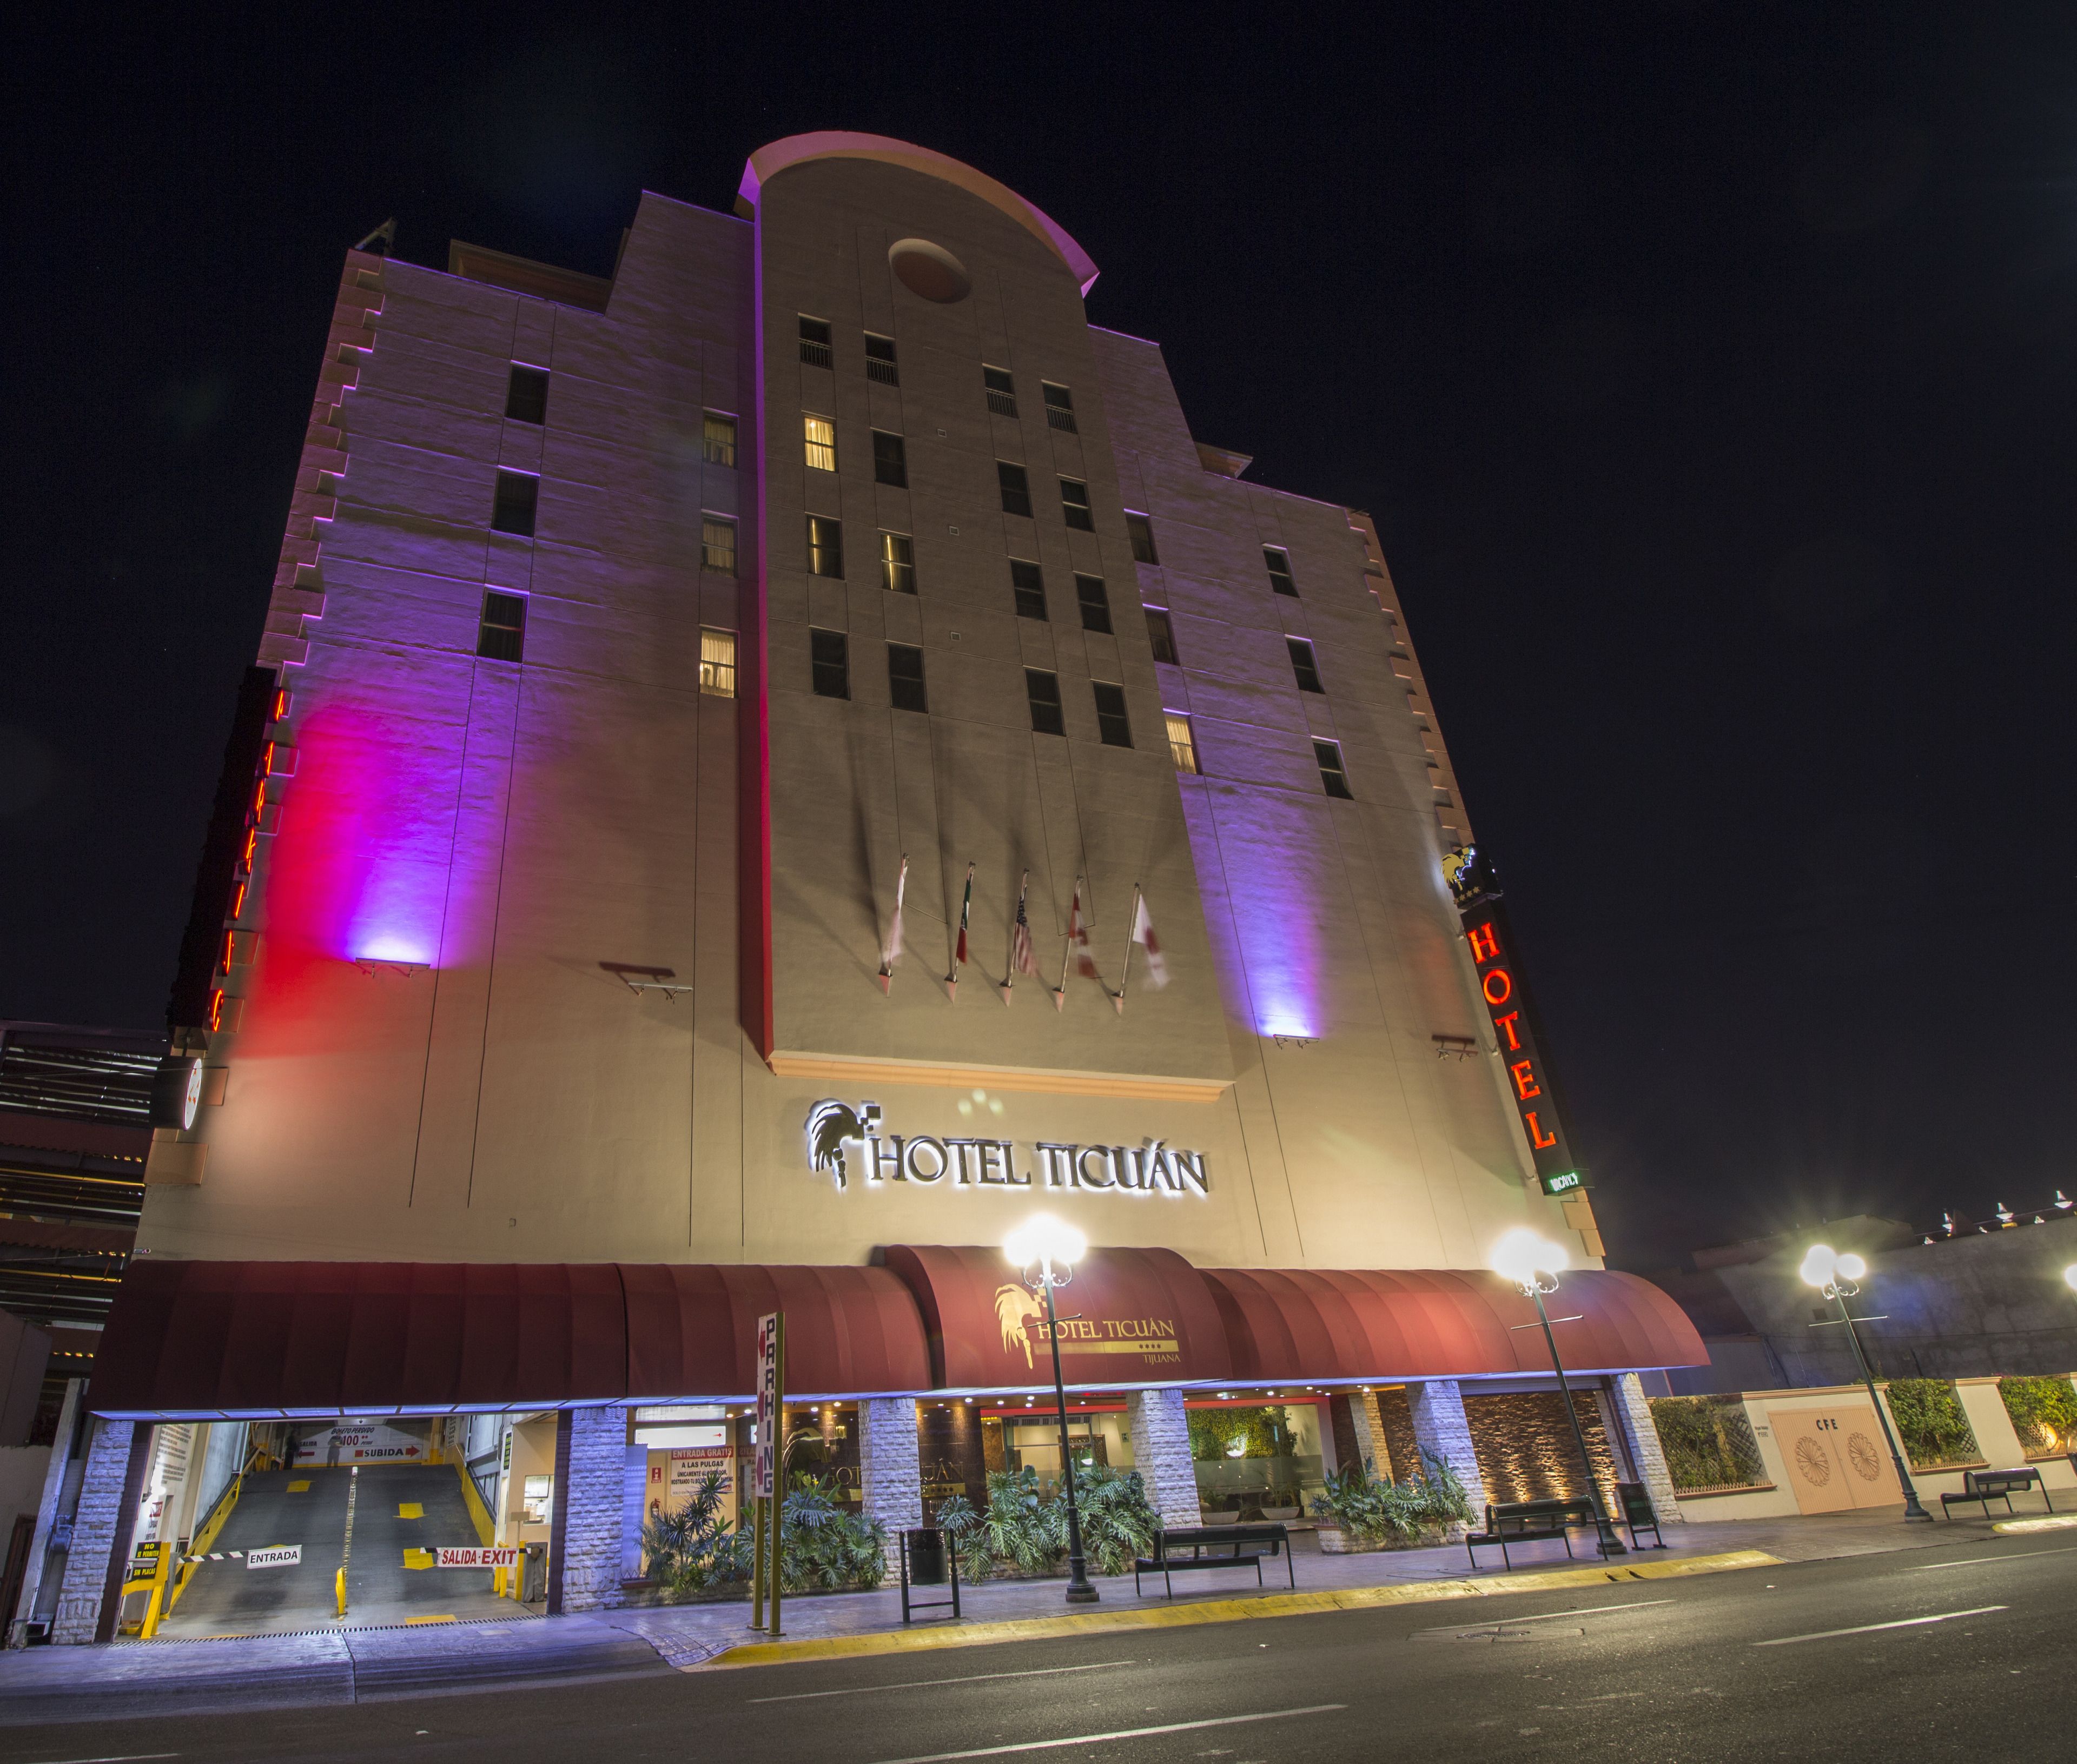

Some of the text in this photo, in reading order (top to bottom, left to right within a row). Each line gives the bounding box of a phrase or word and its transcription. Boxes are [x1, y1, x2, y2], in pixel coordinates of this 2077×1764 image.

[1467, 922, 1556, 1150] HOTEL
[868, 1136, 1209, 1193] HOTEL TICUÁN
[1036, 1317, 1175, 1339] HOTEL TICUÁN
[1142, 1354, 1181, 1365] TIJUANA
[763, 1318, 775, 1493] PARKING
[1816, 1418, 1838, 1431] CFE
[364, 1448, 404, 1457] SUBIDA
[673, 1448, 732, 1458] ENTRADA GRATIS
[250, 1551, 298, 1563] ENTRADA
[442, 1550, 517, 1564] SALIDA EXIT
[142, 1567, 156, 1575] PLACAS
